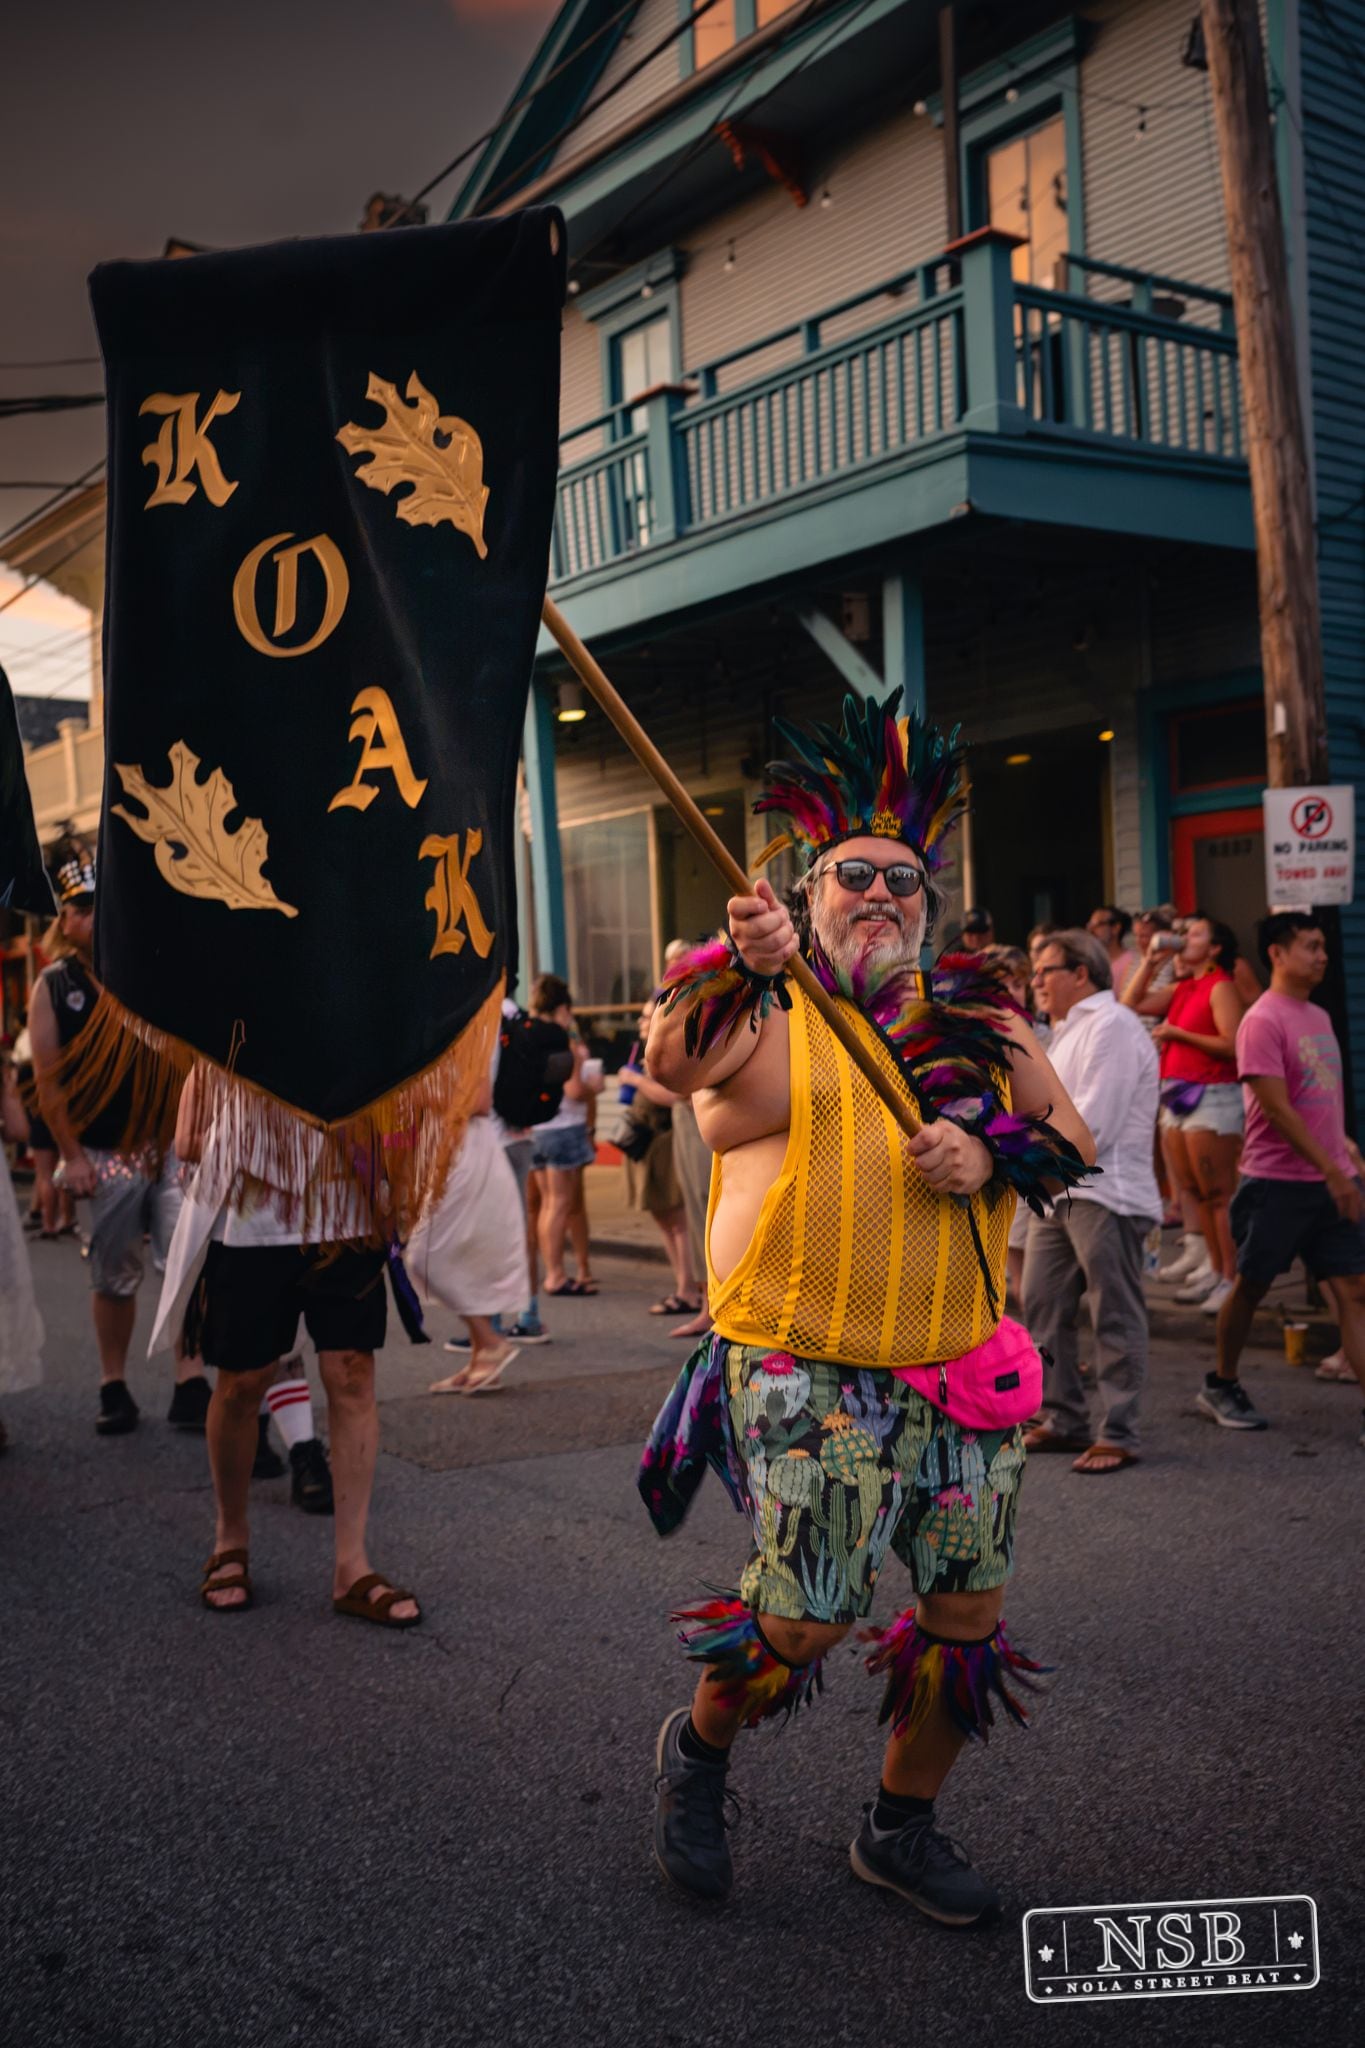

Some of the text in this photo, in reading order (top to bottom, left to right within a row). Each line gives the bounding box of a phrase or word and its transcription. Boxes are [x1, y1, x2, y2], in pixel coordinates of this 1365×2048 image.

[139, 389, 496, 960] K O A K
[1273, 839, 1348, 854] NO PARKING
[1276, 866, 1317, 881] TOWED
